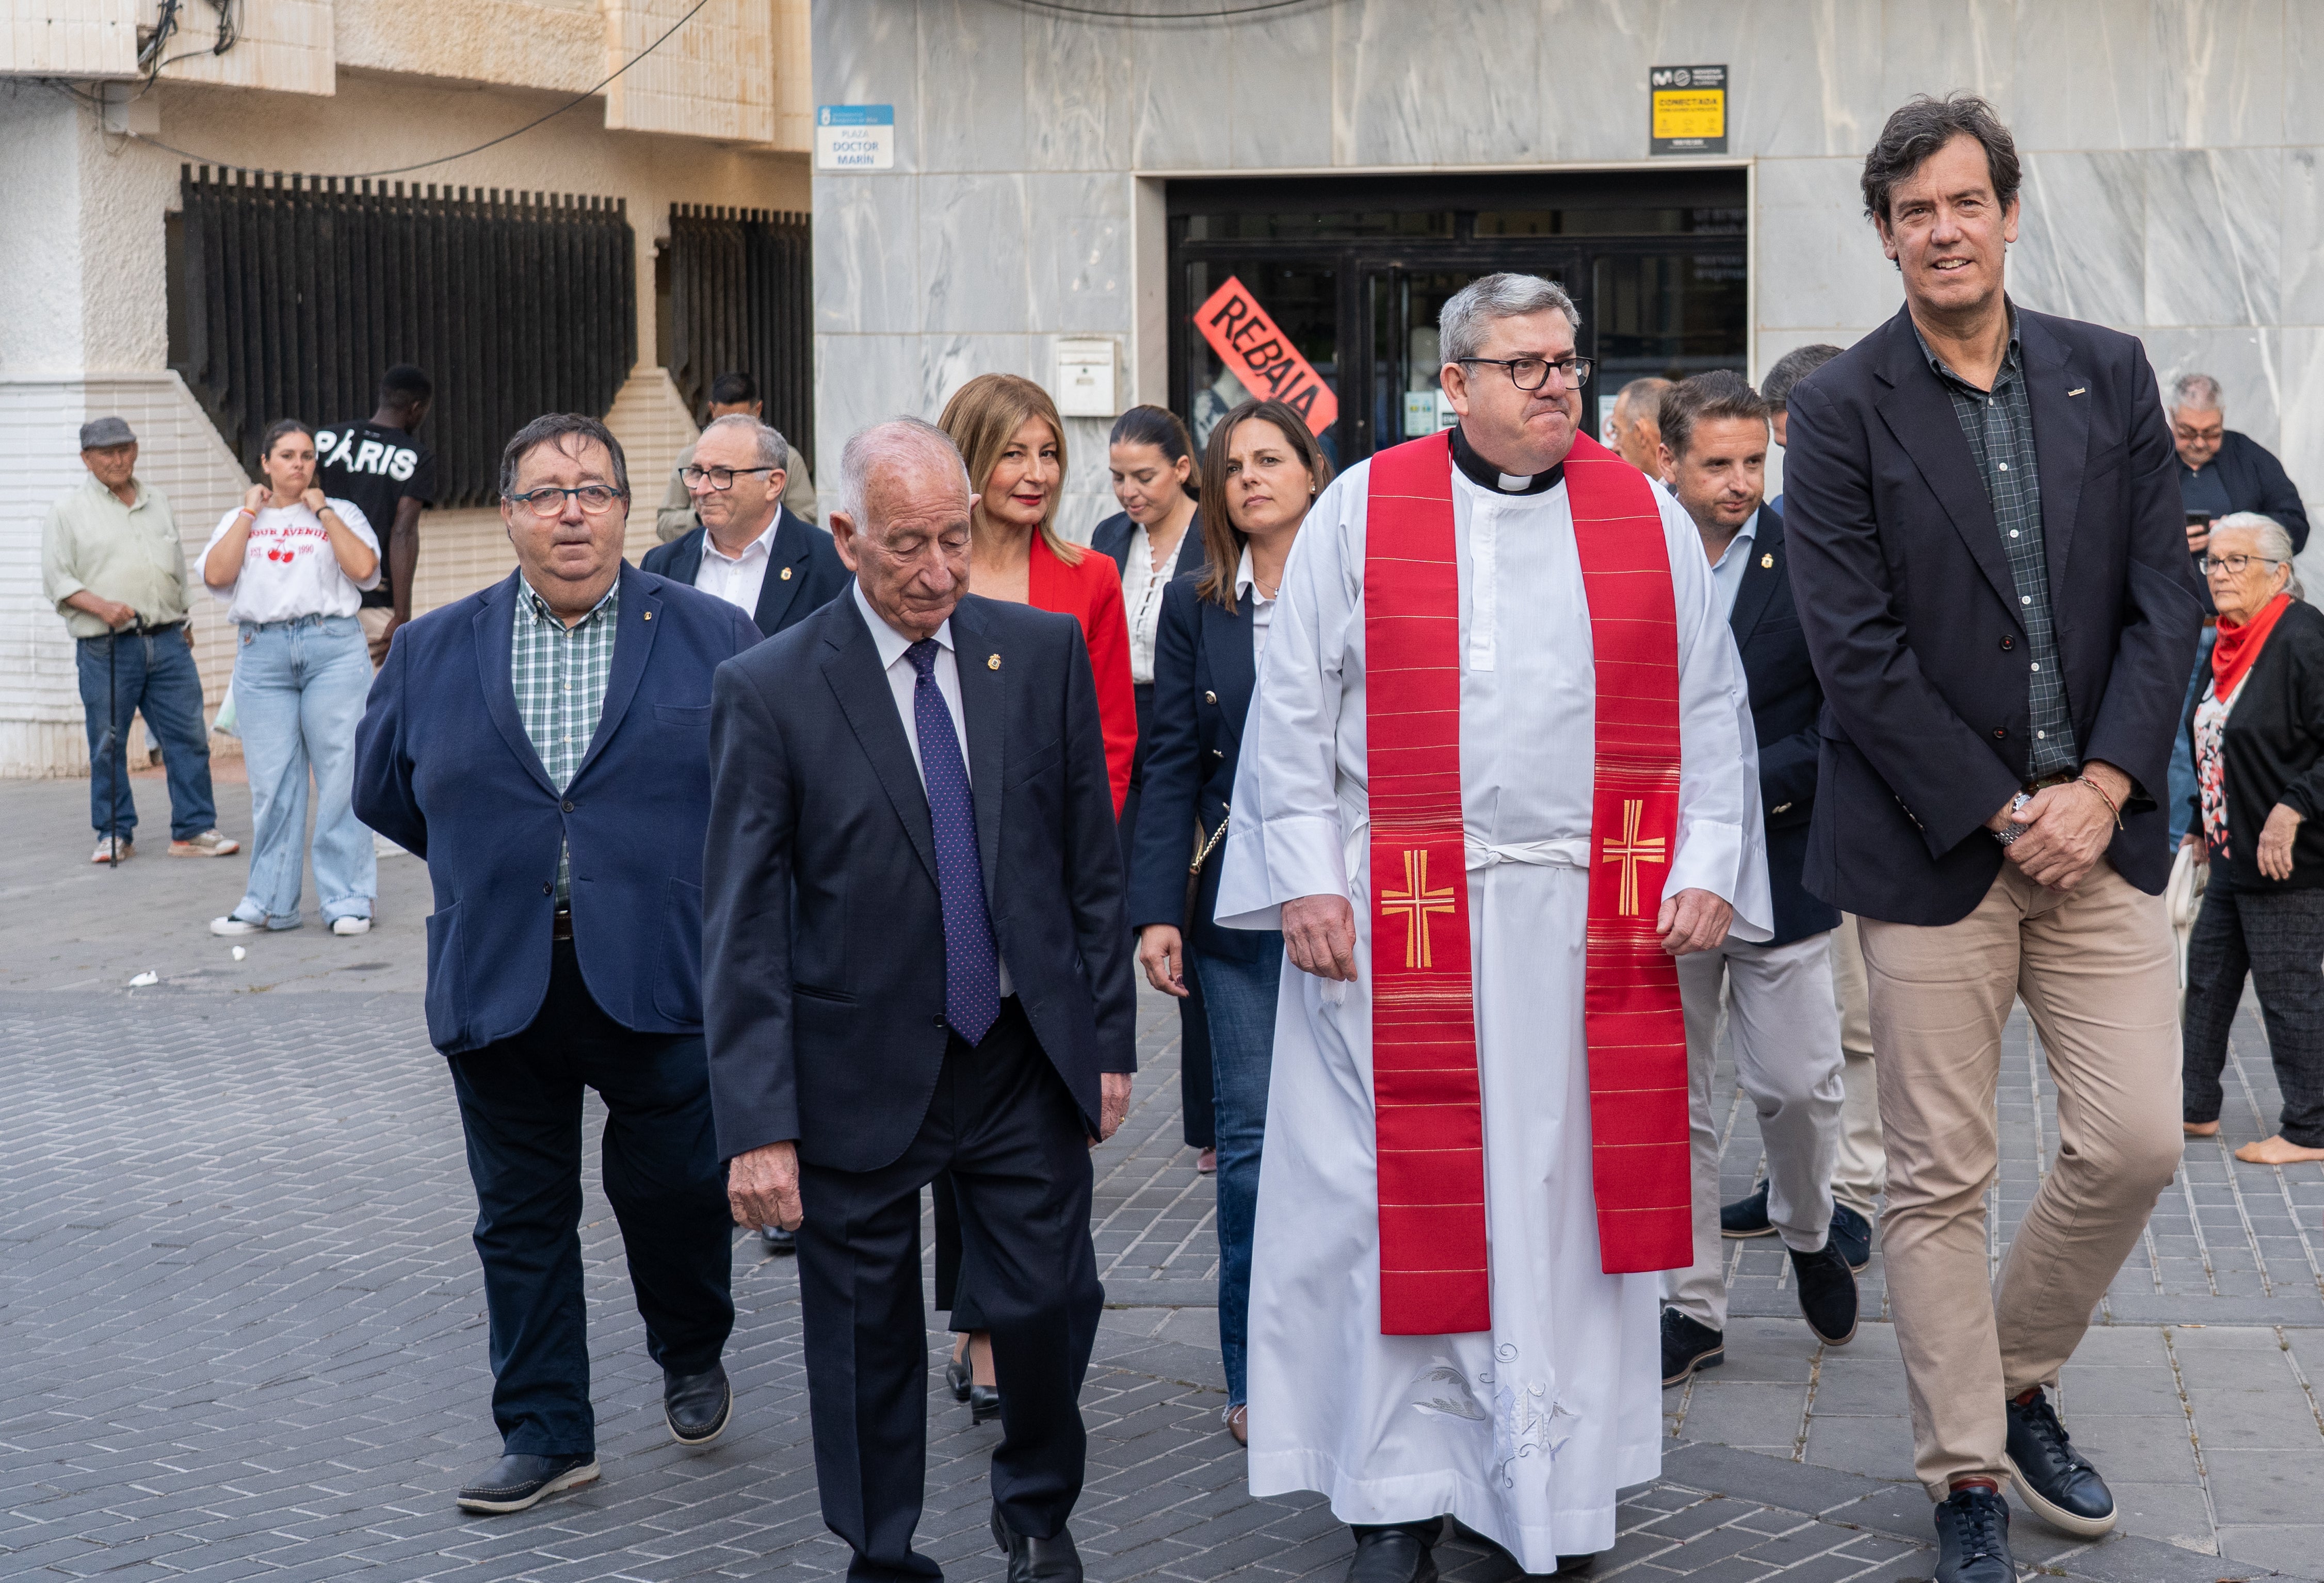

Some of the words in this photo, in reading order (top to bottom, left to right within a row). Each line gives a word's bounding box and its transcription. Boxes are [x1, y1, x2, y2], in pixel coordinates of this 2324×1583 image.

[833, 141, 879, 152] DOCTOR
[315, 429, 417, 481] PARIS
[283, 527, 329, 542] AVENUE
[298, 544, 314, 555] 1990
